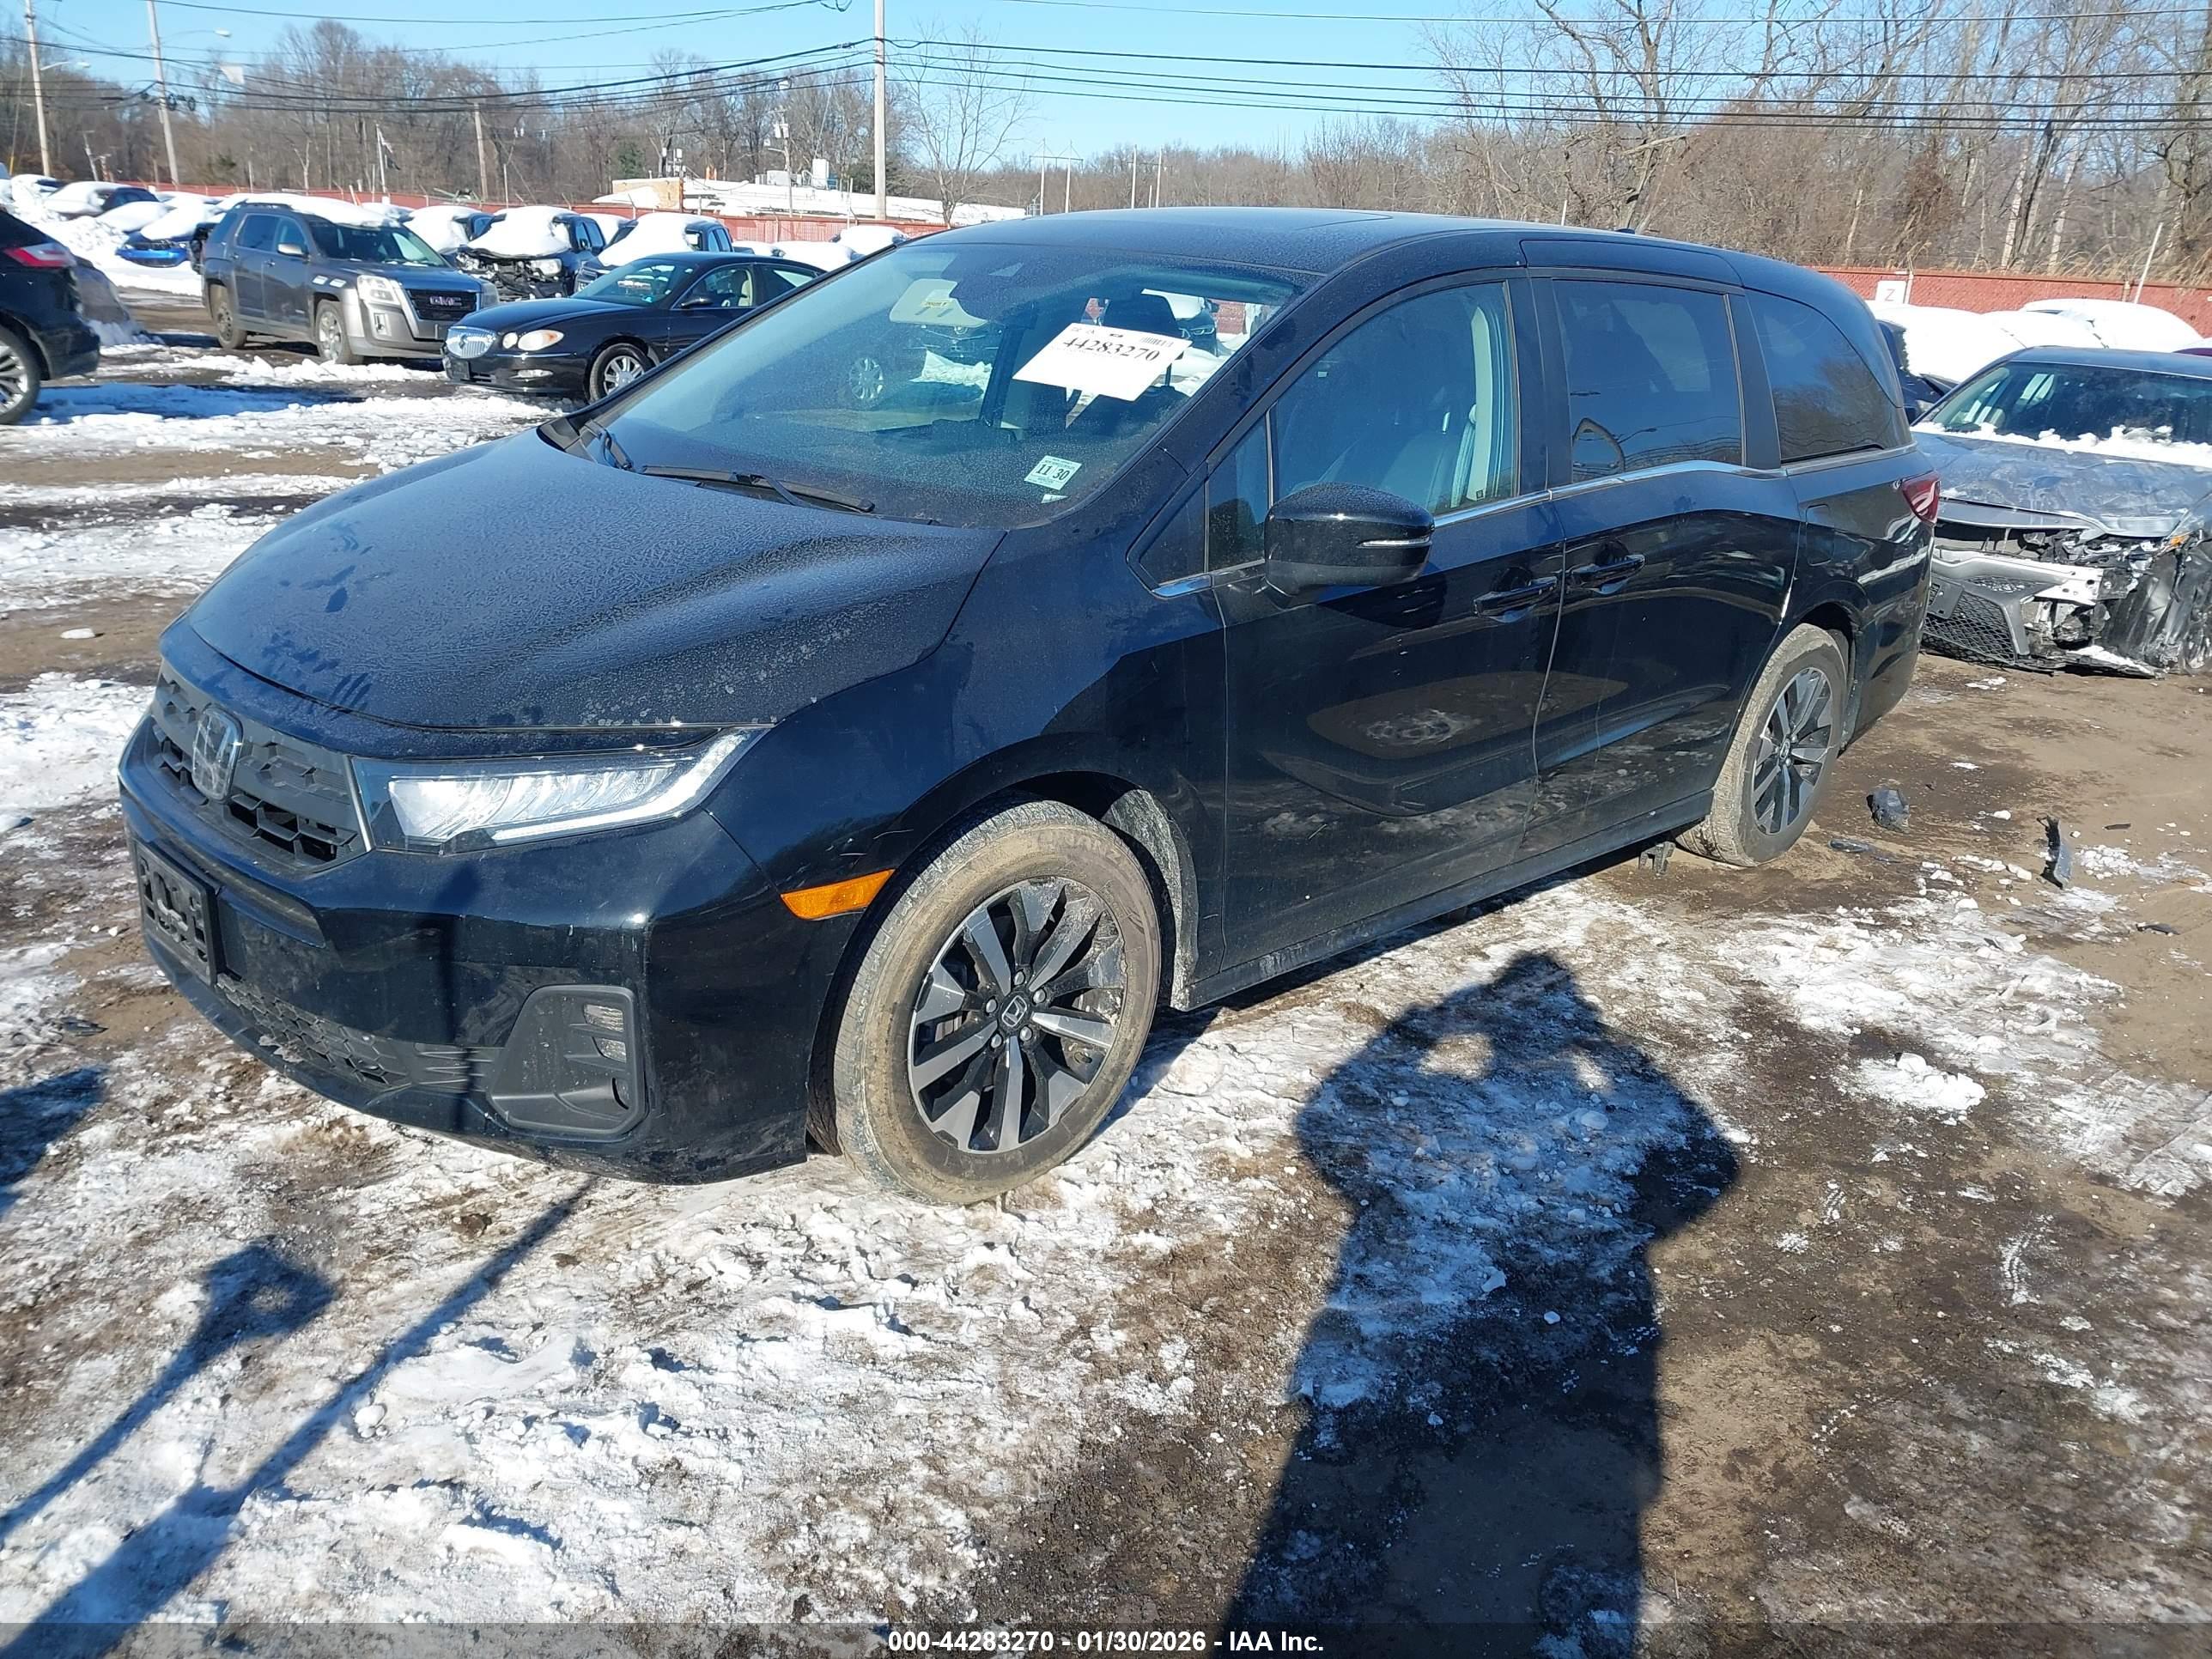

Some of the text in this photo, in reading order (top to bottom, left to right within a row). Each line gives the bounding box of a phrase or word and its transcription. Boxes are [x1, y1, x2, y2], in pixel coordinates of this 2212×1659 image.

[429, 295, 463, 307] GMC
[1884, 288, 1897, 302] Z
[1062, 336, 1160, 362] 44283270
[1035, 463, 1054, 476] 11
[1052, 468, 1071, 481] 30
